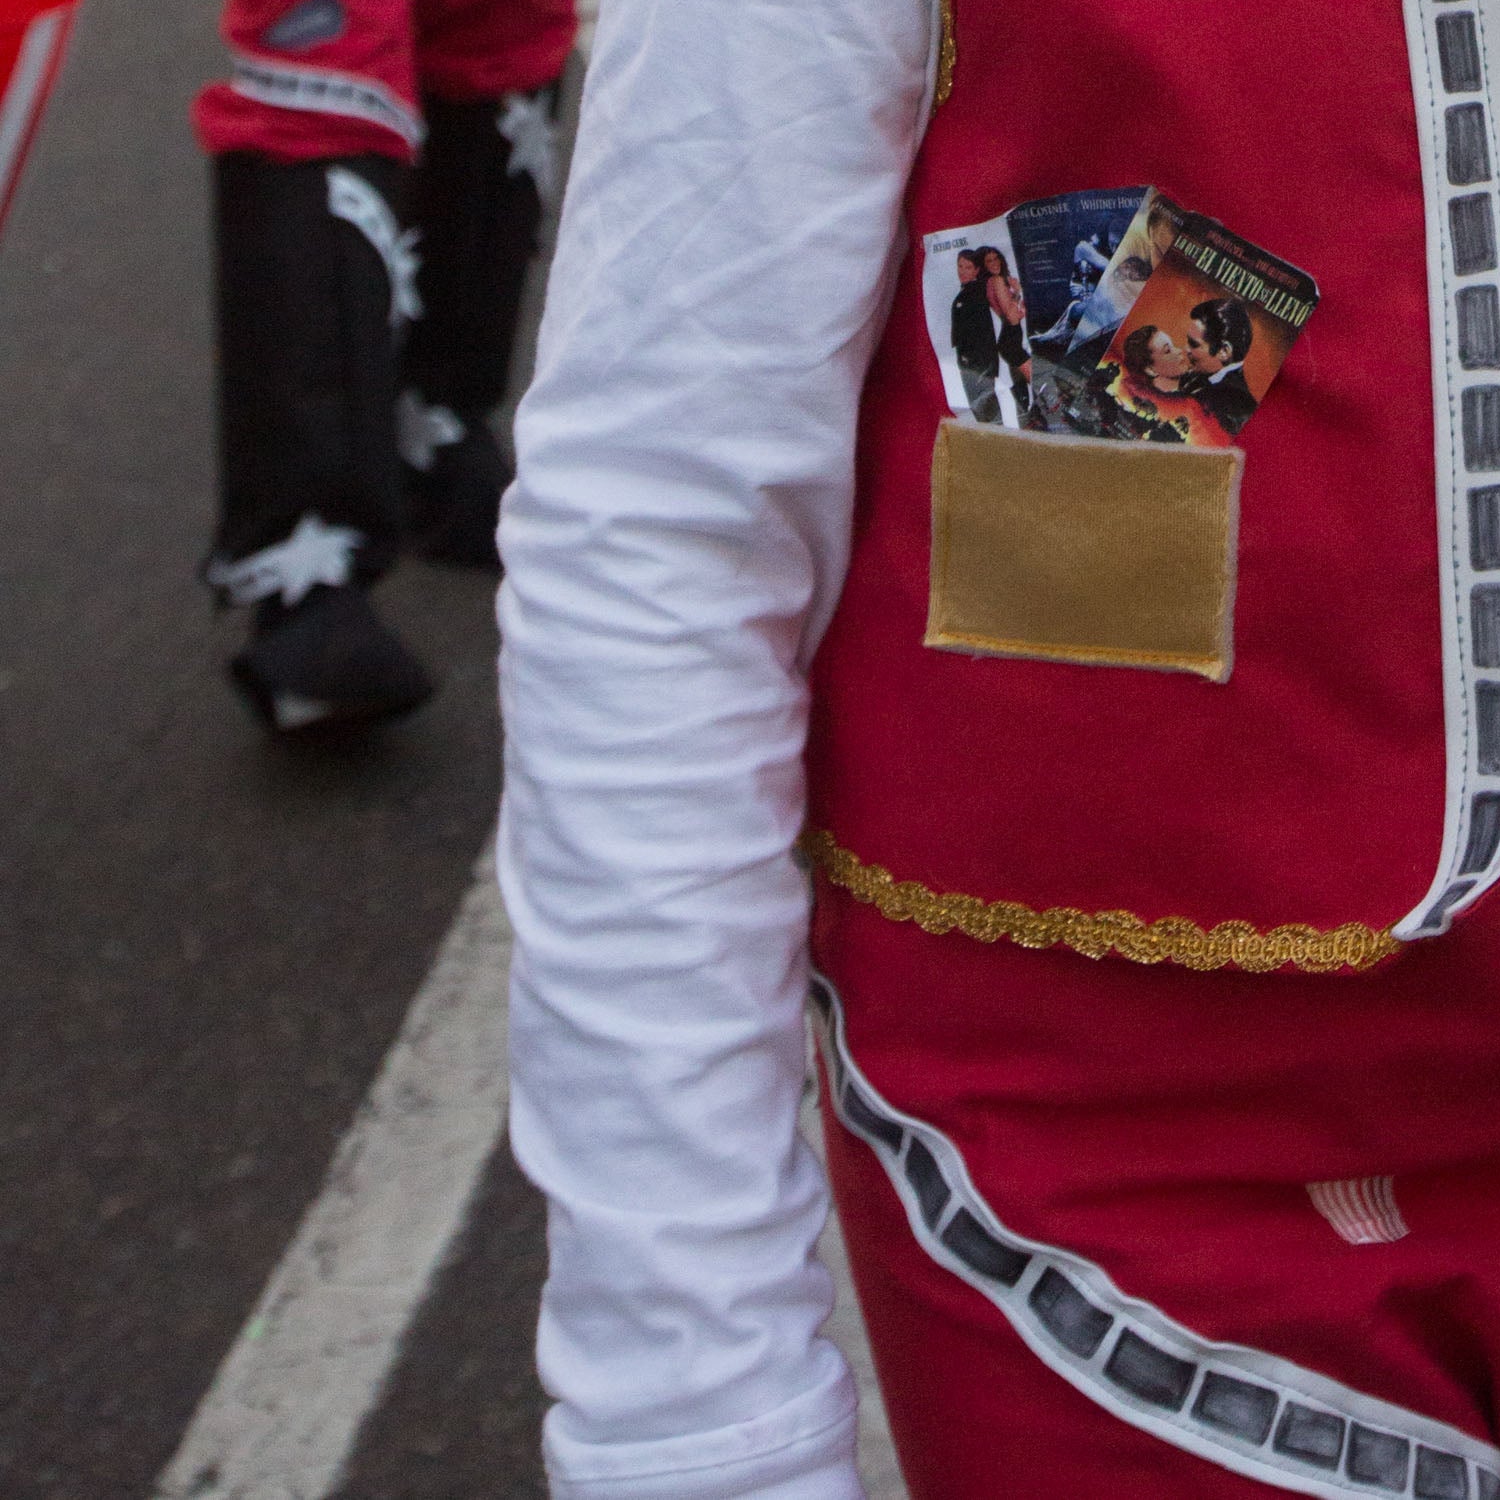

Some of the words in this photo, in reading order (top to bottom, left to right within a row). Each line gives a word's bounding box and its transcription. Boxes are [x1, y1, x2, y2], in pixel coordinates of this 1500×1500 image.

[1196, 246, 1218, 274] EL
[1215, 257, 1264, 301] VIENTO
[1264, 287, 1313, 327] LLEVÓ
